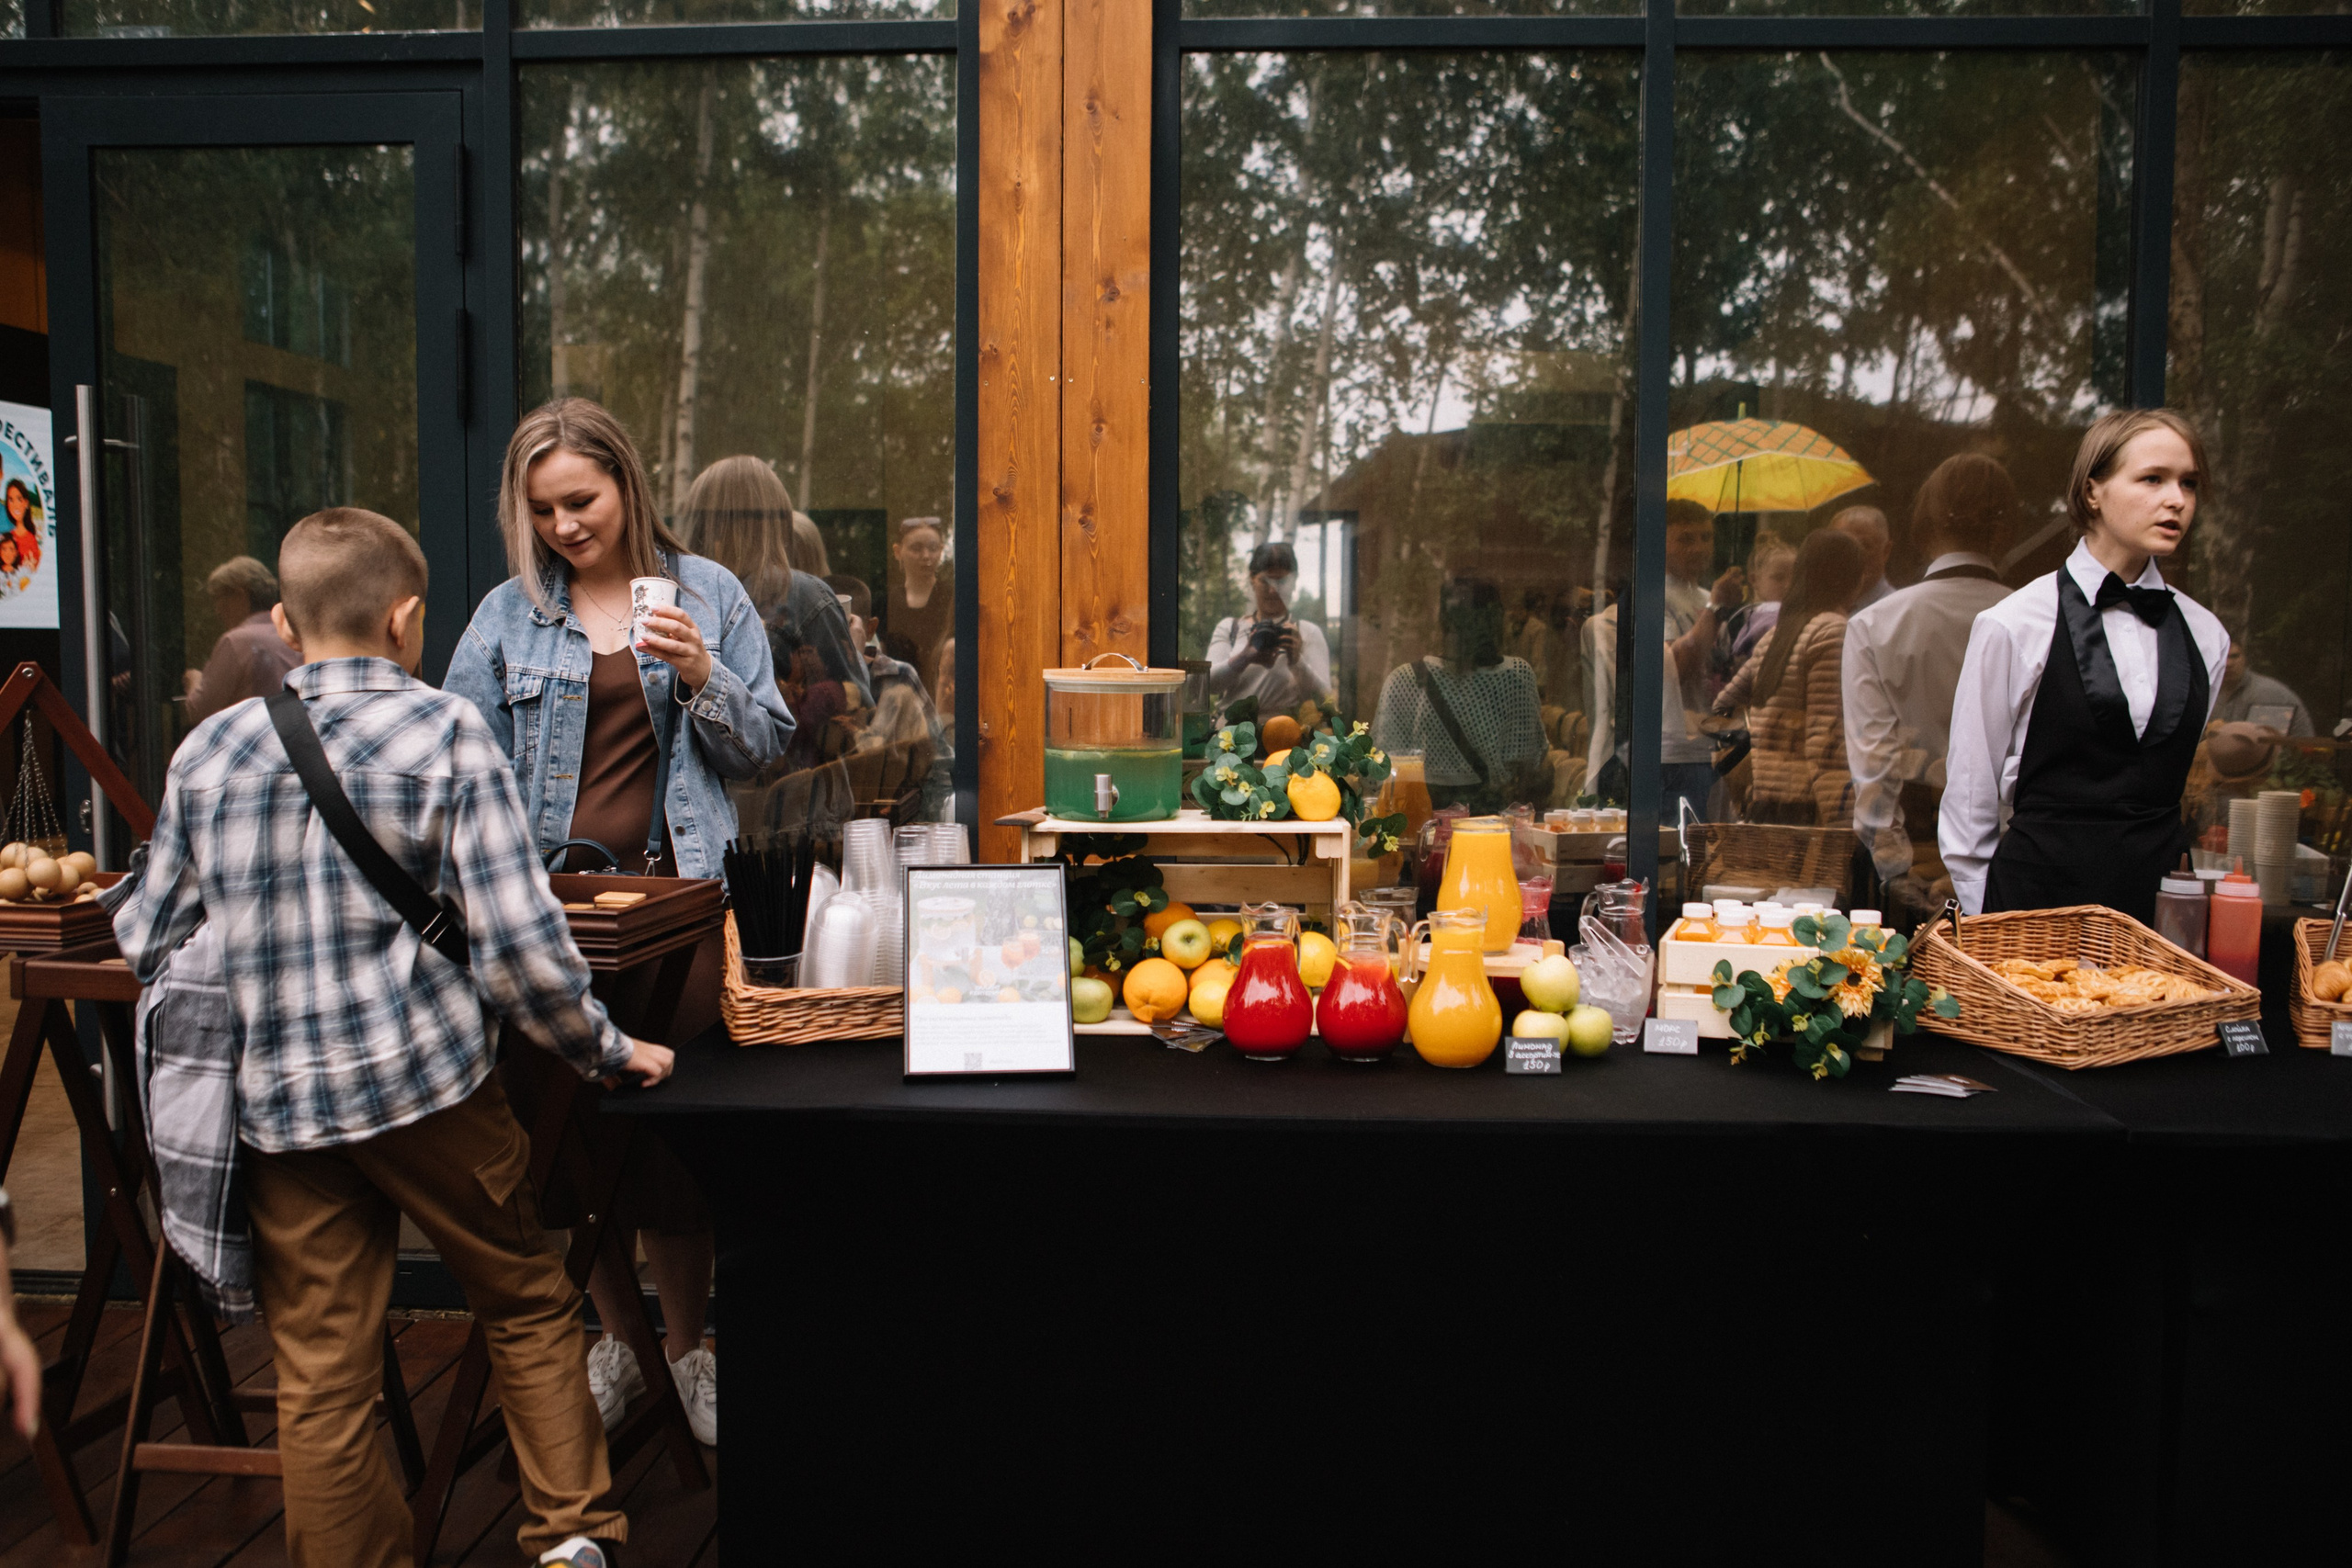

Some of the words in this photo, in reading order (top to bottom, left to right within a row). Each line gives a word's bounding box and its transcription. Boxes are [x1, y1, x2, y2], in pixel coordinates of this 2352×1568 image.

[0, 419, 56, 537] ЕСТИВАЛЬ
[913, 871, 976, 880] Лимонадная
[977, 872, 1021, 881] станция
